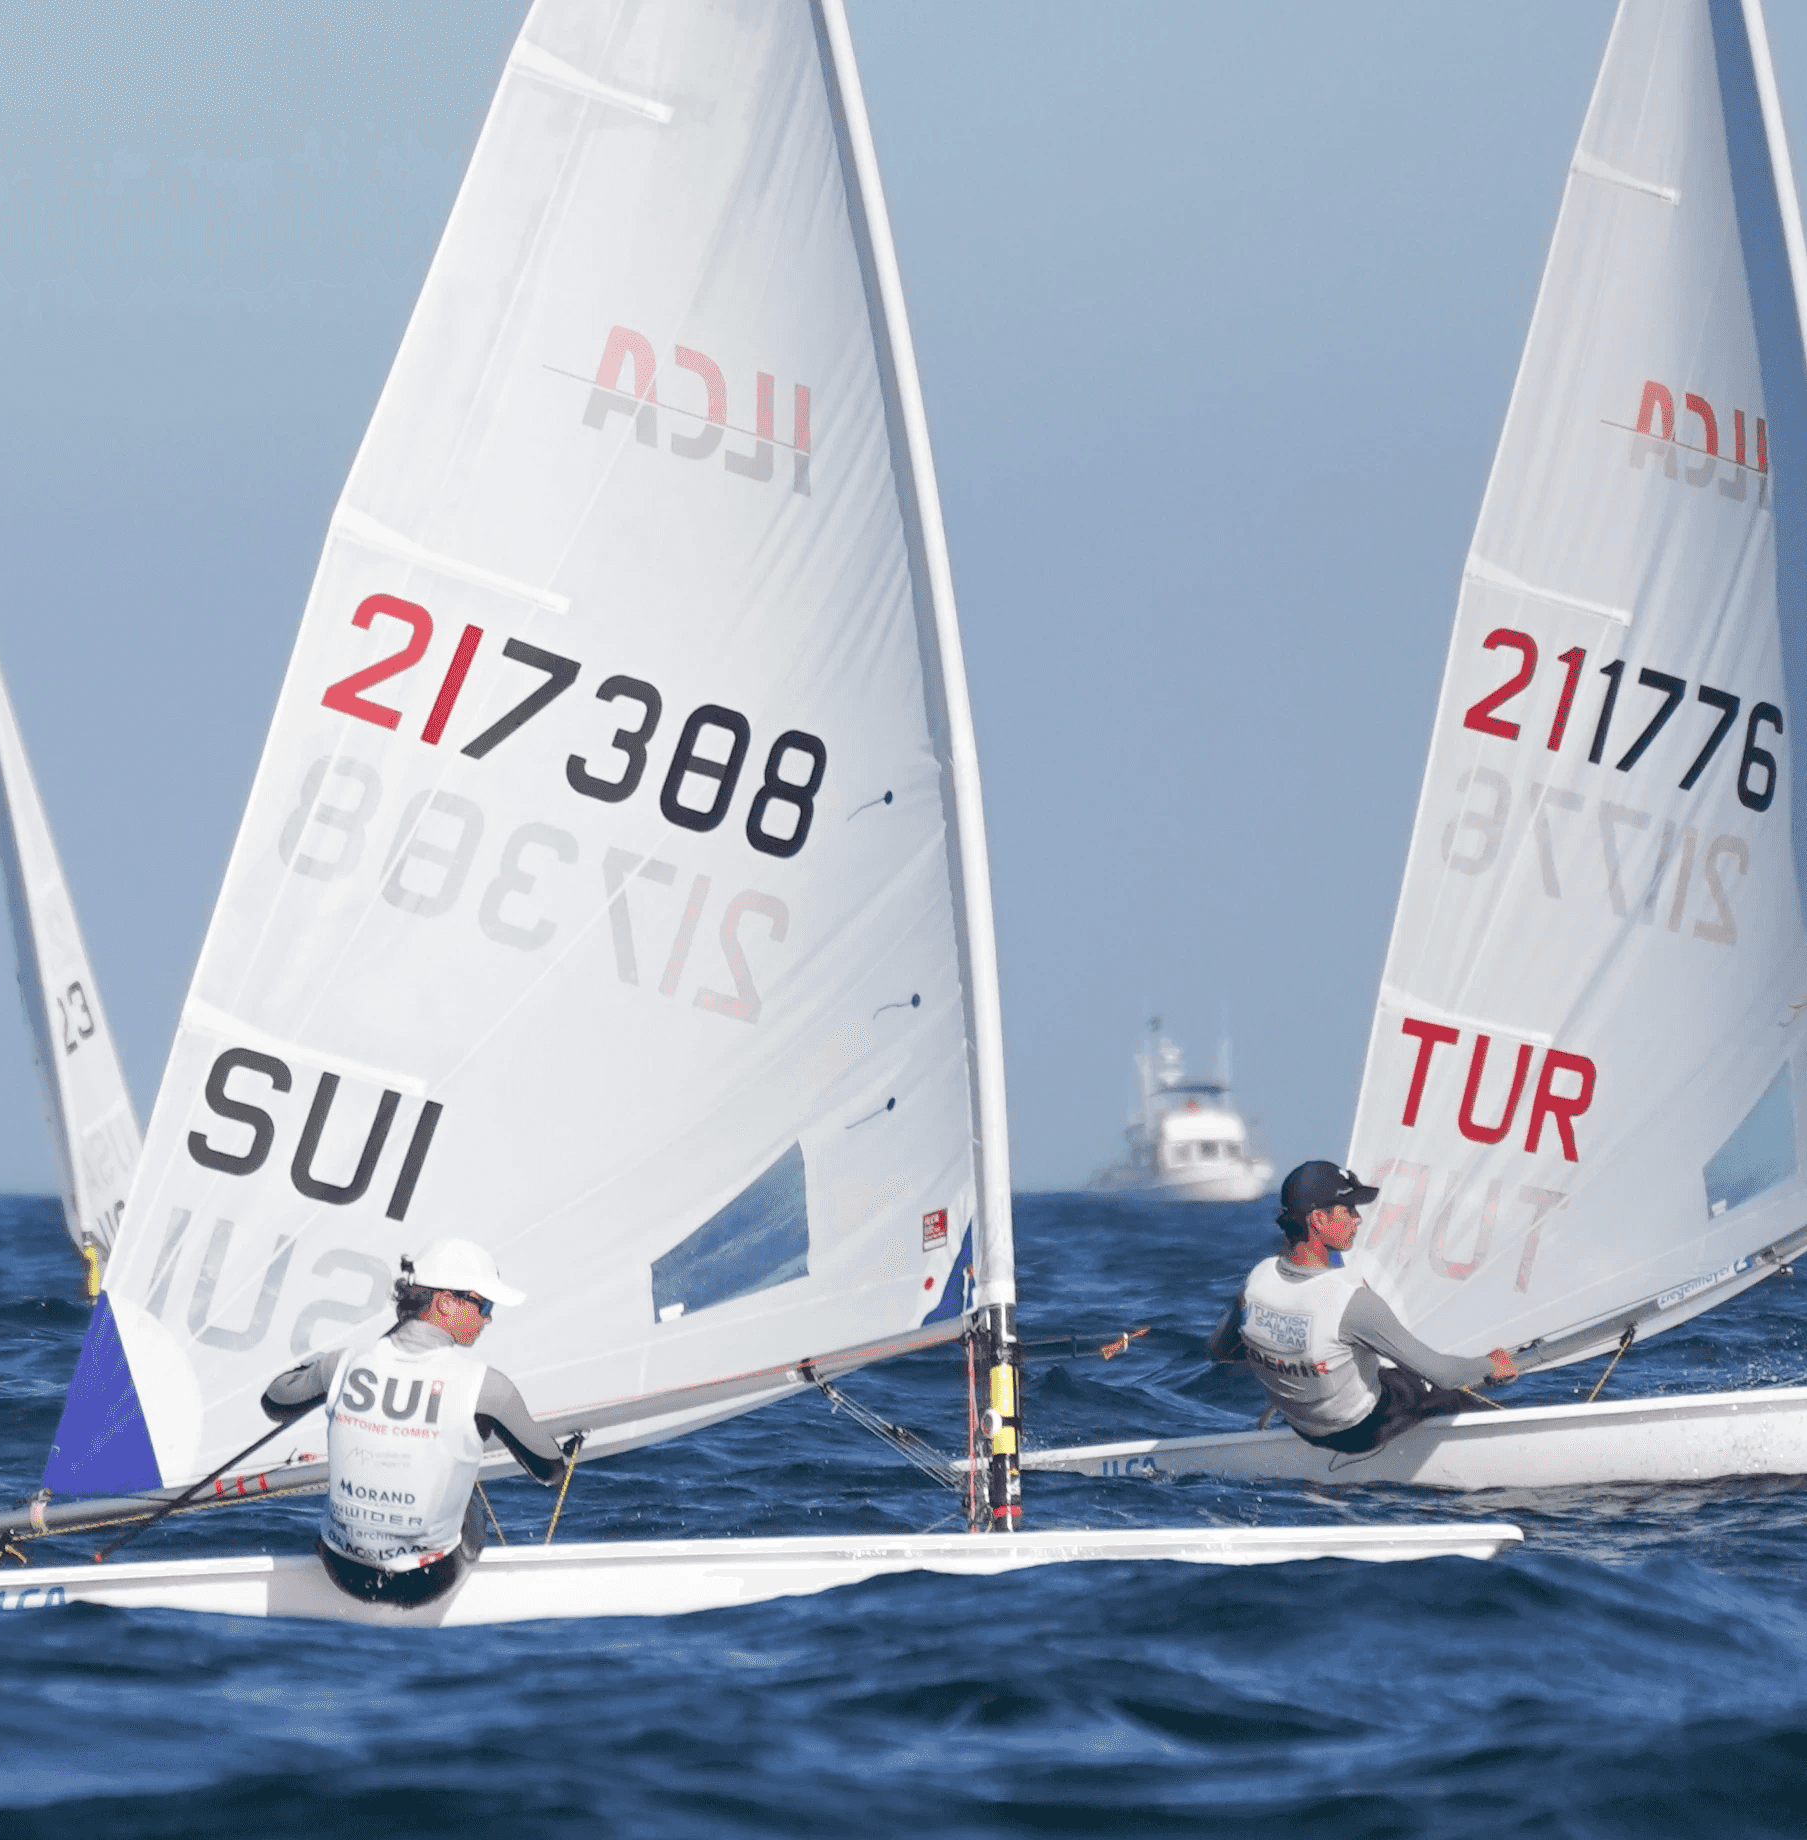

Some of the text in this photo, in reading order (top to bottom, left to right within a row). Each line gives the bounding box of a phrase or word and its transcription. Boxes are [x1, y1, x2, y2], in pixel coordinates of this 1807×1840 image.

[321, 592, 827, 859] 217388
[1462, 627, 1784, 813] 211776
[1401, 1017, 1598, 1162] TUR
[187, 1047, 444, 1222] SUI
[1253, 1305, 1309, 1328] TURKISH
[1254, 1316, 1307, 1339] SAILING
[1269, 1330, 1307, 1349] TEAM
[335, 1412, 389, 1435] ANTOINE
[340, 1478, 417, 1505] MORAND
